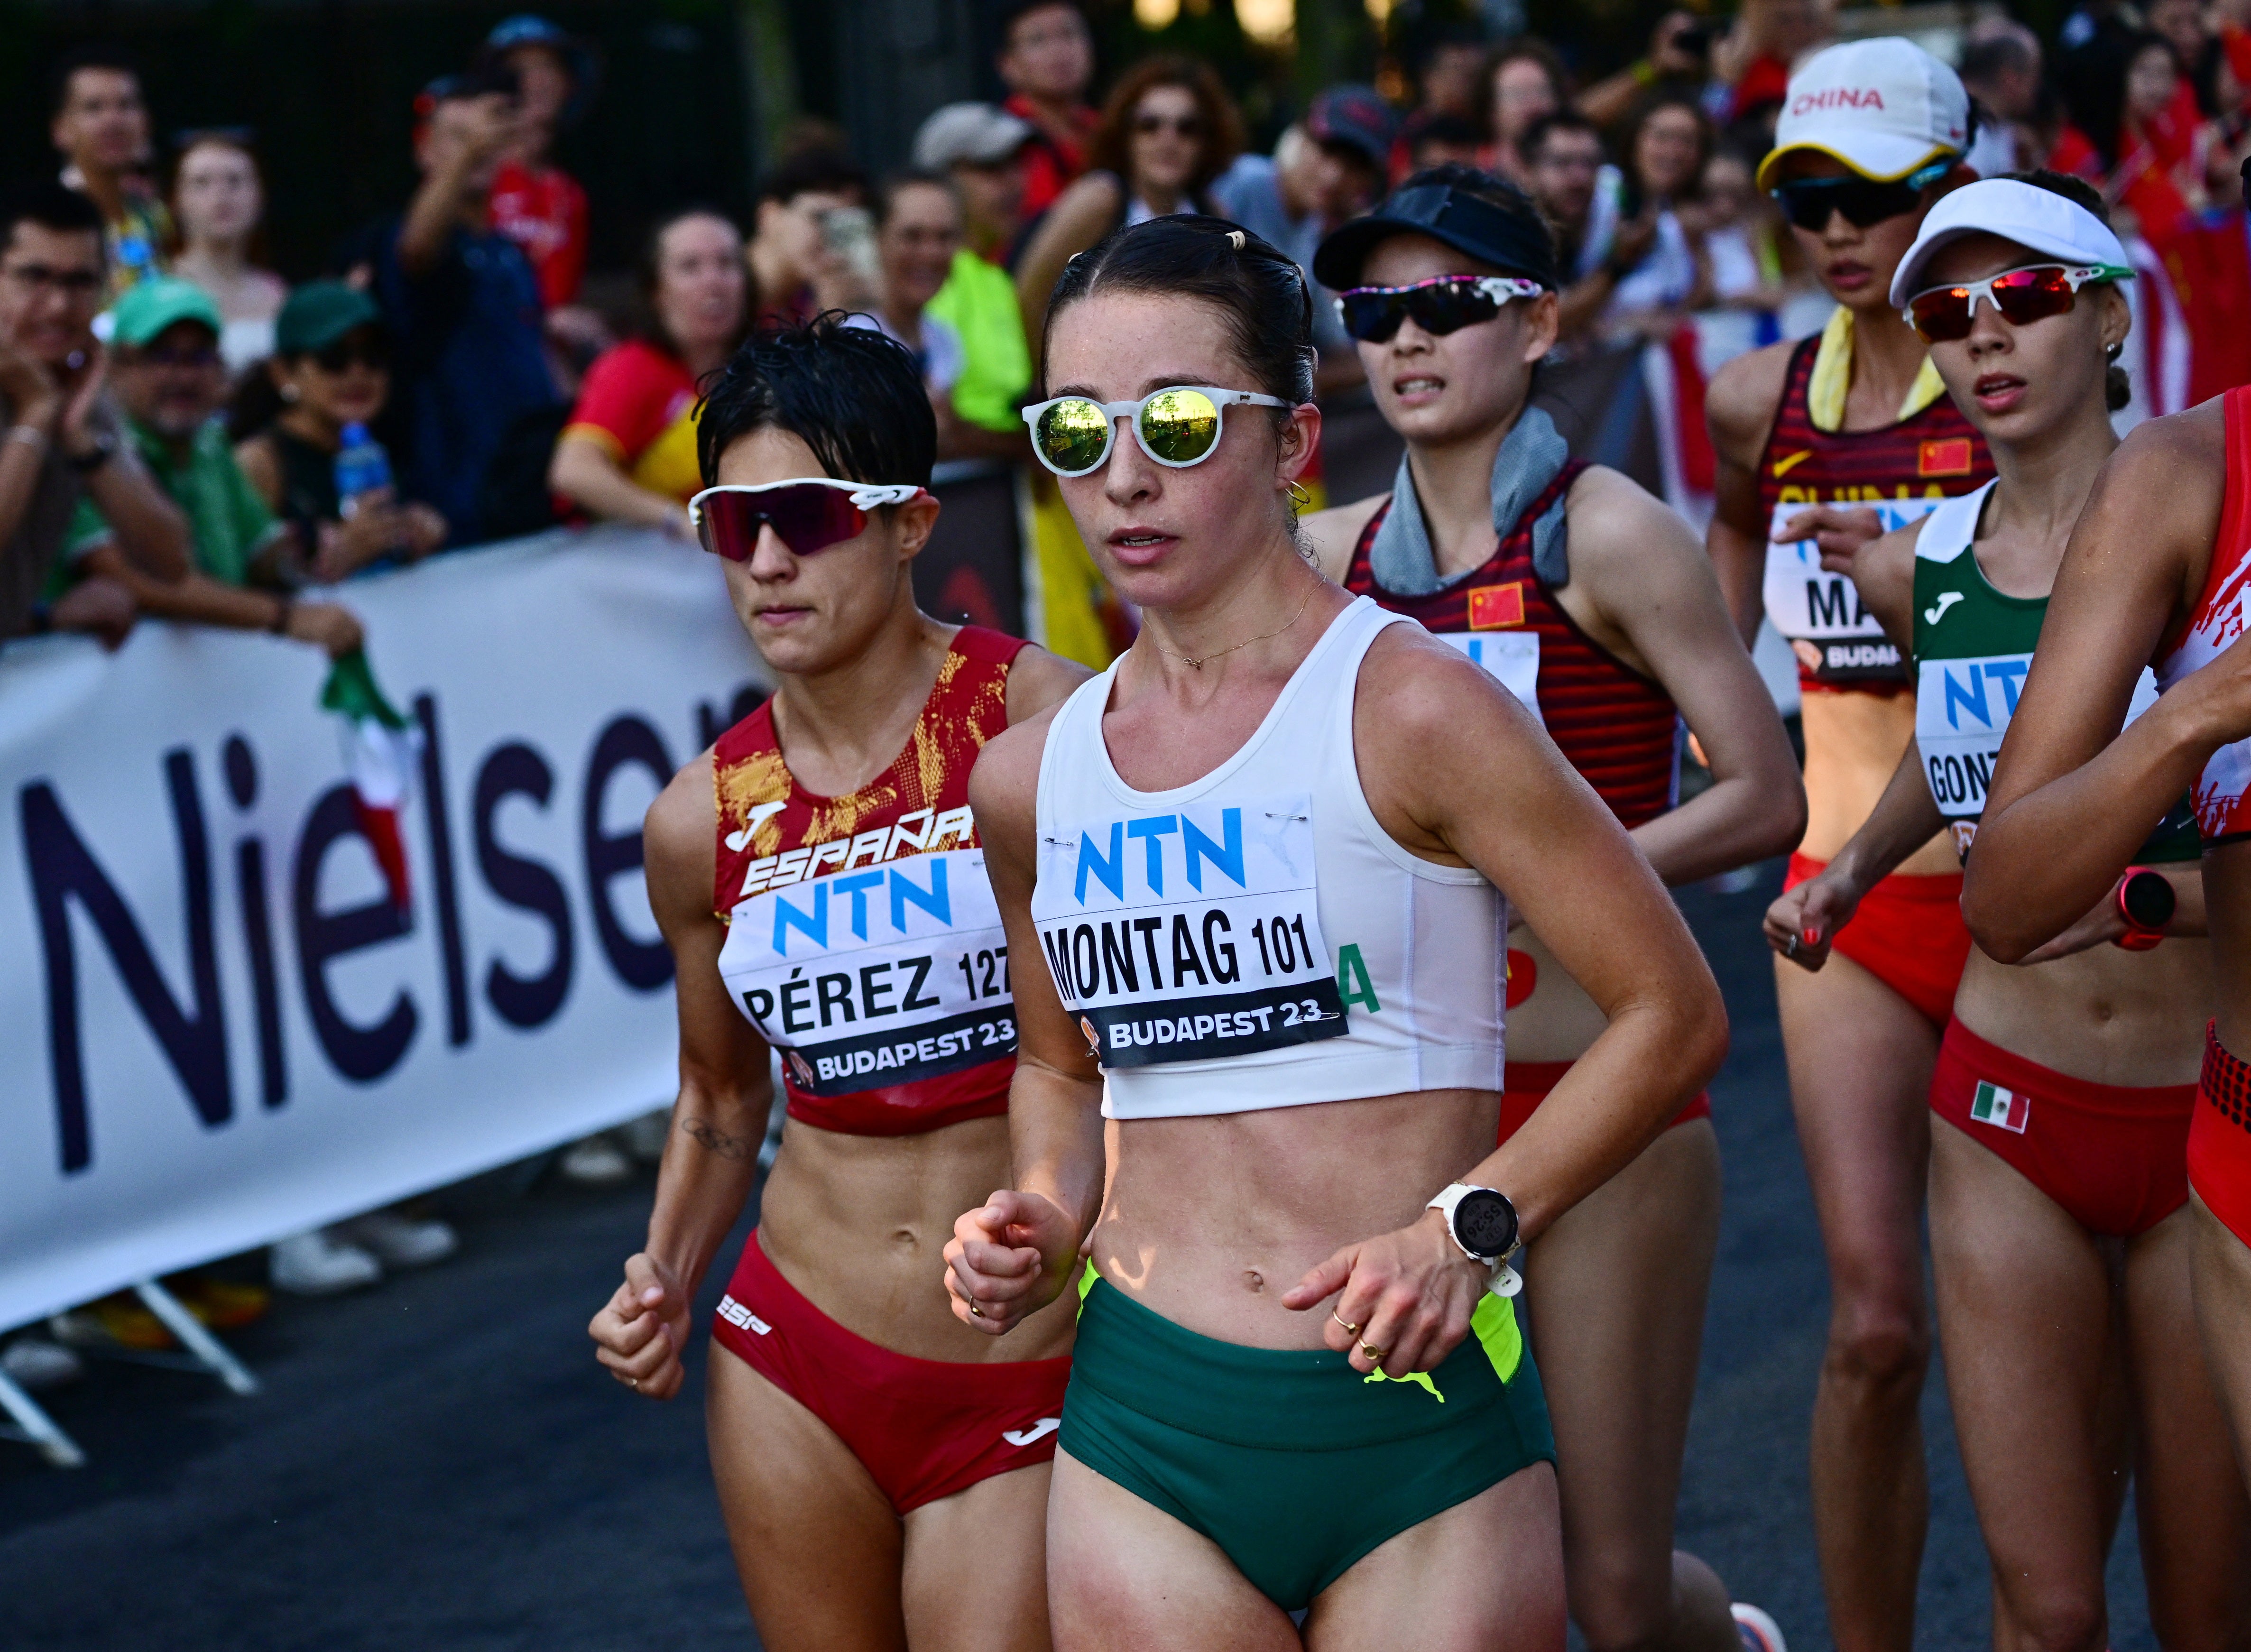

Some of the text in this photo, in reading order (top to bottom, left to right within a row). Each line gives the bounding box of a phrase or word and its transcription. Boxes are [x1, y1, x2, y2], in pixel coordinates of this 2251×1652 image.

[1793, 87, 1884, 117] CHINA
[1945, 661, 2031, 730] NT
[739, 805, 974, 896] ESPAÑA
[1074, 807, 1246, 907] NTN
[773, 858, 951, 958] NTN
[742, 946, 1011, 1036] PÉREZ 127
[1043, 909, 1314, 1001] MONTAG 101
[817, 1018, 1015, 1081] BUDAPEST 23
[1109, 999, 1322, 1049] BUDAPEST 23
[716, 1293, 772, 1336] ESP
